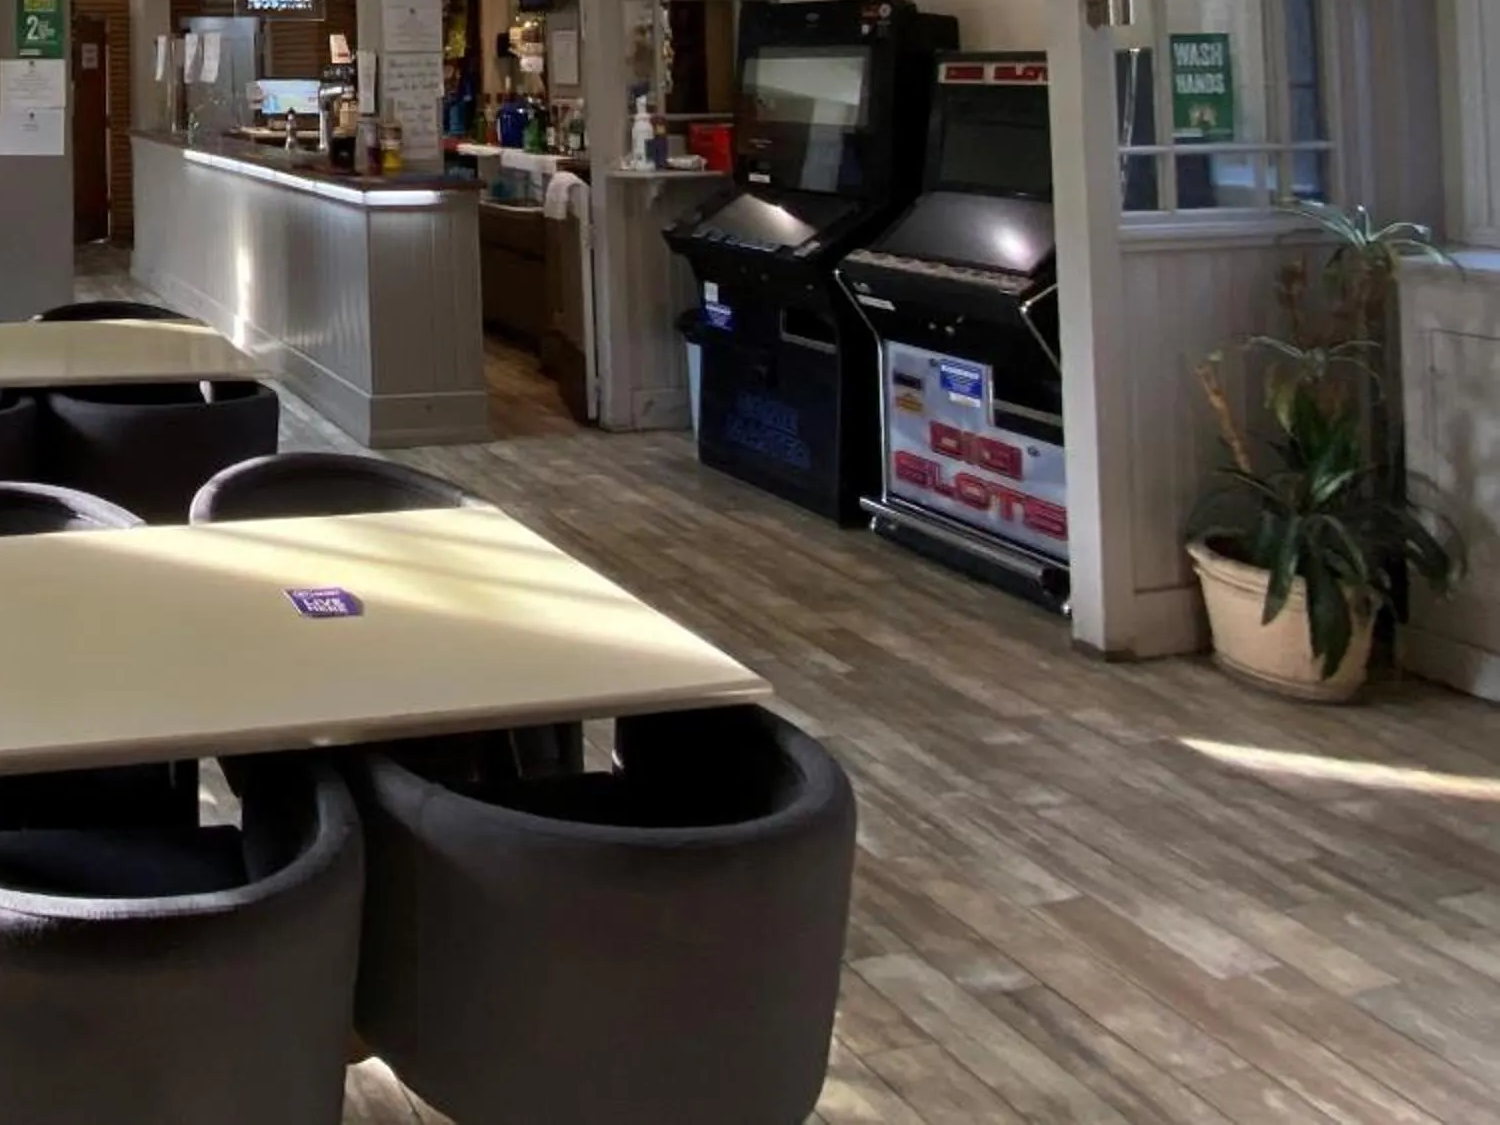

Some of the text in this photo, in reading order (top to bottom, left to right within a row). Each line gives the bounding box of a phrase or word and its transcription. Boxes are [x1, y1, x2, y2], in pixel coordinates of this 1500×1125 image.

[1173, 42, 1224, 66] WASH
[1176, 73, 1226, 94] HANDS
[894, 450, 1069, 541] SLOTS
